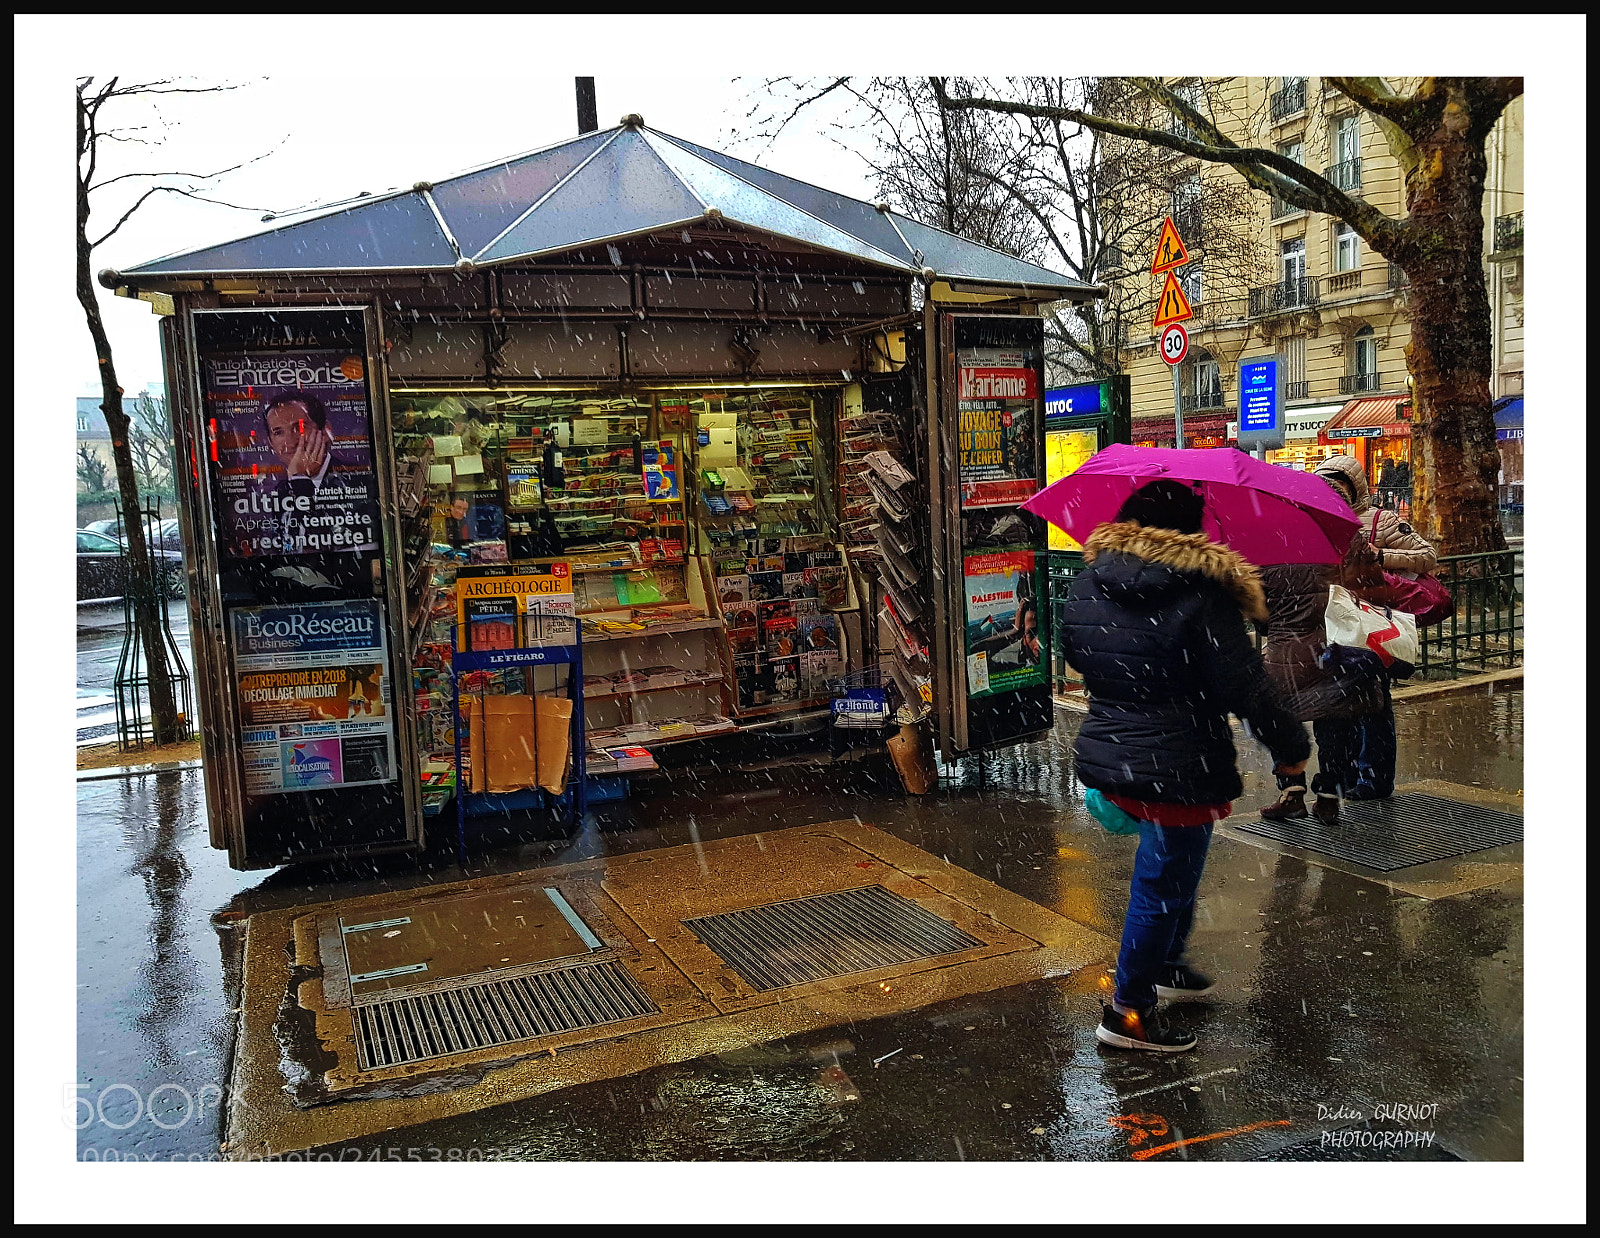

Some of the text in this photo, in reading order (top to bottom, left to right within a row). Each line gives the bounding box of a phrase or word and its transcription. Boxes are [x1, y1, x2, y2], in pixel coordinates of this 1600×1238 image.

[1165, 334, 1183, 354] 30
[212, 359, 308, 371] Informations
[961, 368, 1027, 398] Marianne
[958, 410, 1002, 432] VOYAGE
[1299, 419, 1329, 431] SUCC
[959, 431, 1002, 451] AU BOUT
[1506, 429, 1524, 439] LIB
[970, 450, 1003, 466] L'ENFER
[314, 487, 343, 497] Patrick
[234, 491, 311, 514] altice
[235, 517, 280, 533] Après
[303, 510, 372, 529] tempête
[465, 578, 562, 598] ARCHÉOLOGIE
[972, 591, 1014, 604] PALESTINE
[479, 605, 504, 614] PÉTRA
[724, 601, 757, 611] SAVEURS
[244, 611, 374, 638] EcoRéseau
[249, 636, 302, 651] Business
[490, 652, 546, 663] LE FIGARO
[244, 669, 347, 689] ENTREPRENDRE EN 2018
[244, 683, 338, 703] DÉCOLLAGE IMMÉDIAT
[846, 699, 880, 712] Monde
